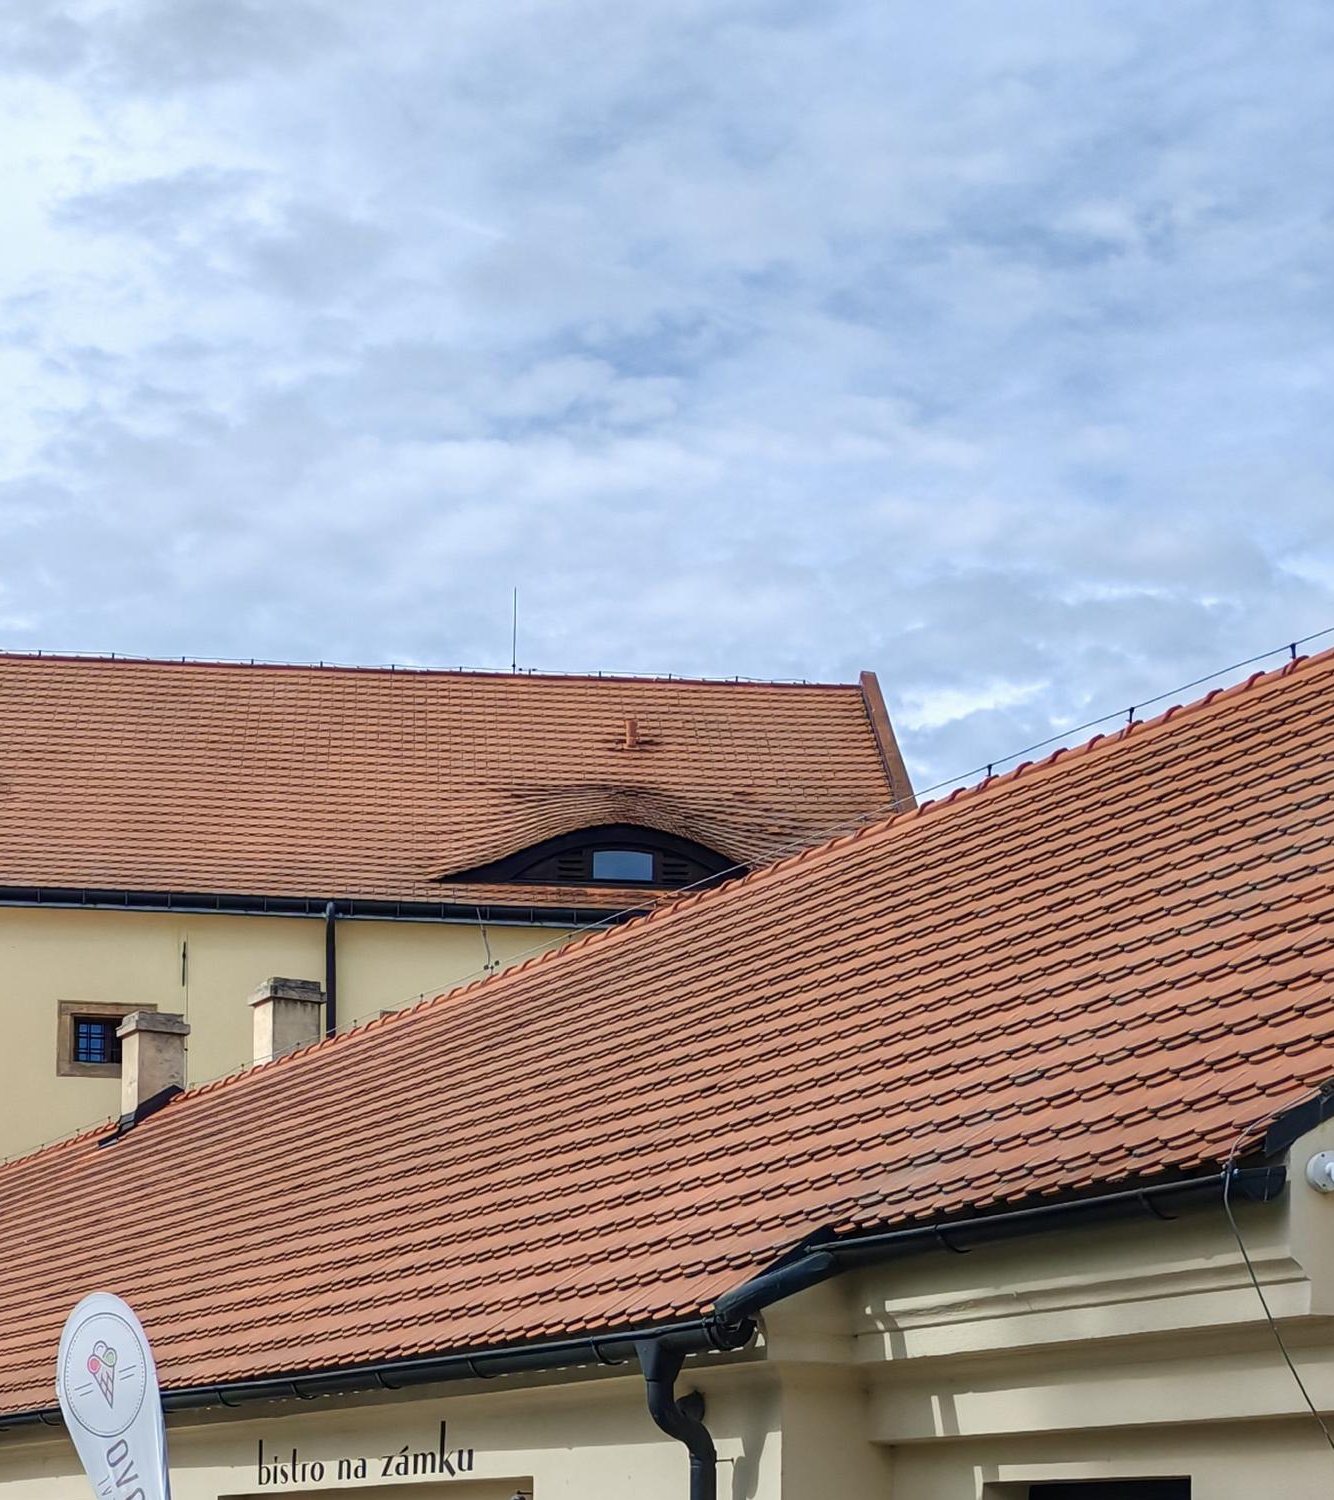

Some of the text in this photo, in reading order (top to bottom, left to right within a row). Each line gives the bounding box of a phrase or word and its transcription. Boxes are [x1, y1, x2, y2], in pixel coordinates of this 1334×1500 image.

[258, 1420, 474, 1486] bistro na zámku
